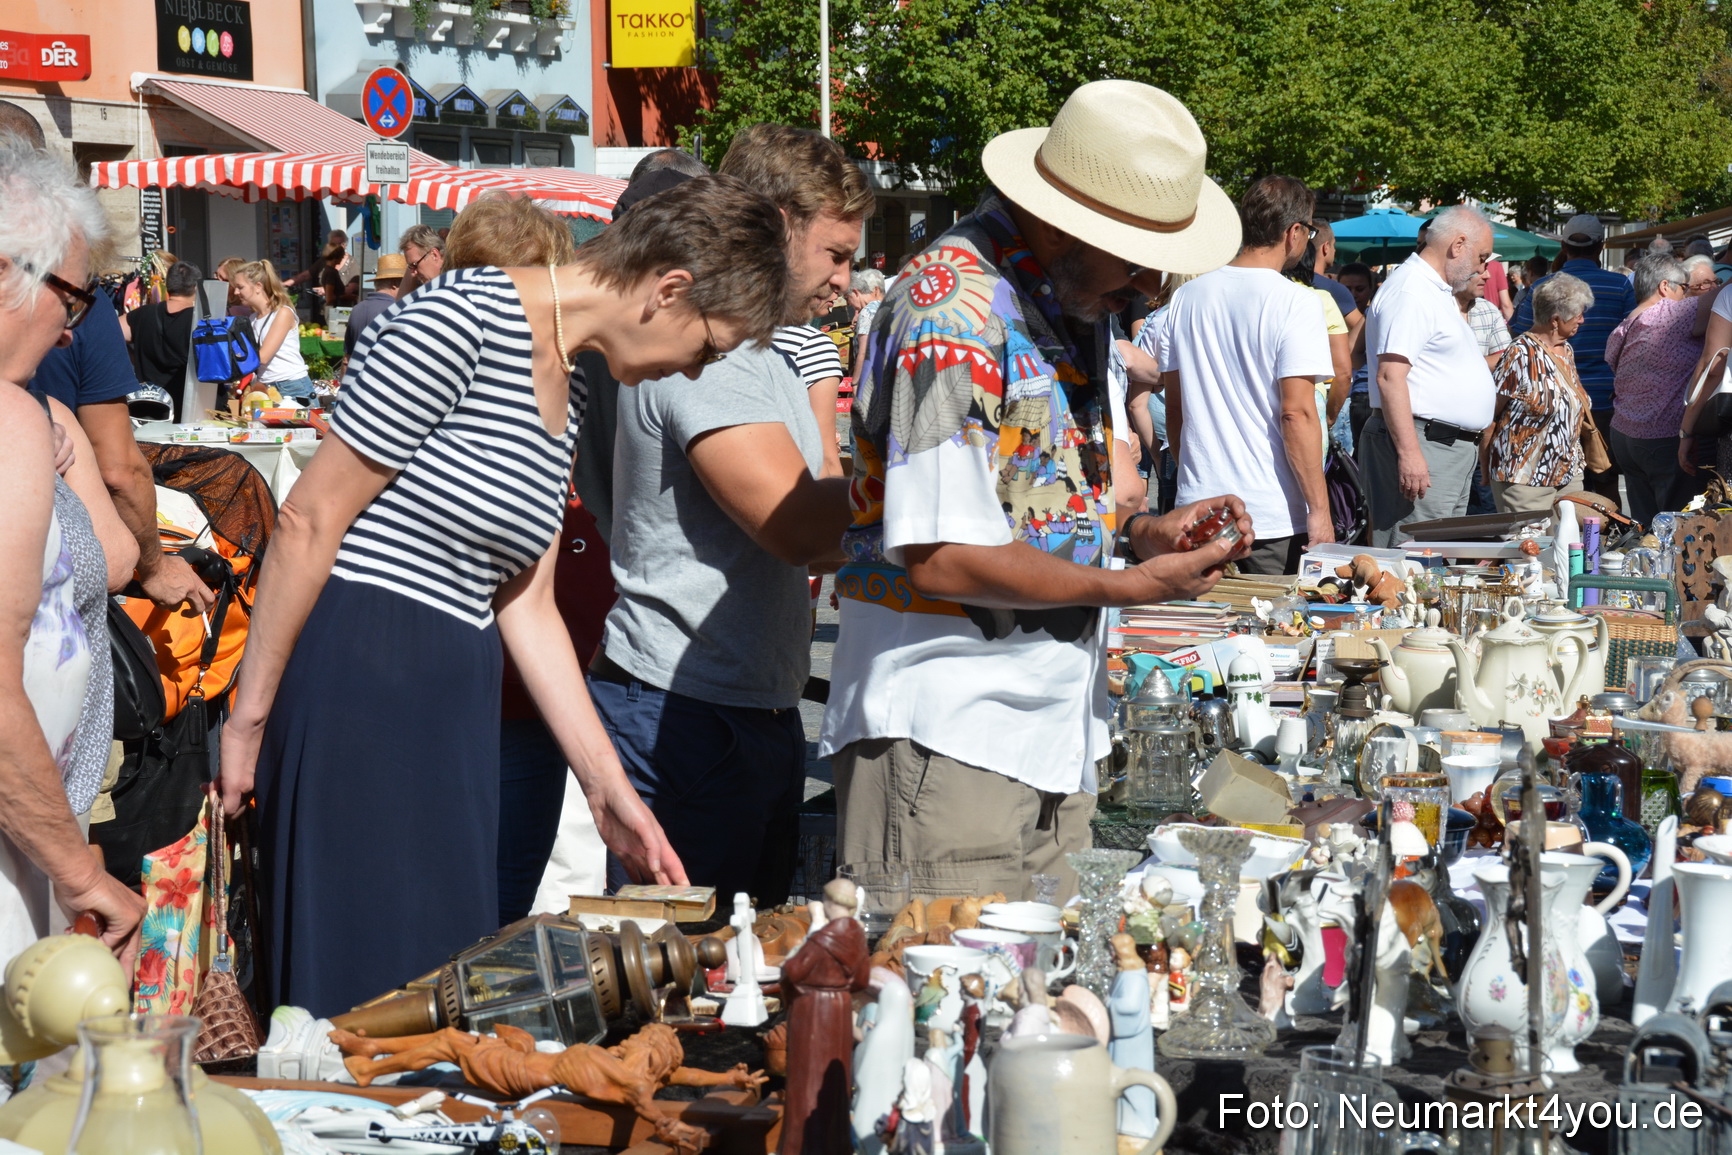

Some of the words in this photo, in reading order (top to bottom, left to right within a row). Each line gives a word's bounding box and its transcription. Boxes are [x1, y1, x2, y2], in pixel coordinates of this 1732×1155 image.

[41, 46, 79, 67] DER
[176, 57, 195, 68] OBST
[197, 60, 204, 70] &
[206, 60, 239, 74] GEMÜSE
[100, 107, 108, 120] 15
[369, 150, 406, 161] Wendebereich
[375, 165, 401, 175] freihalten
